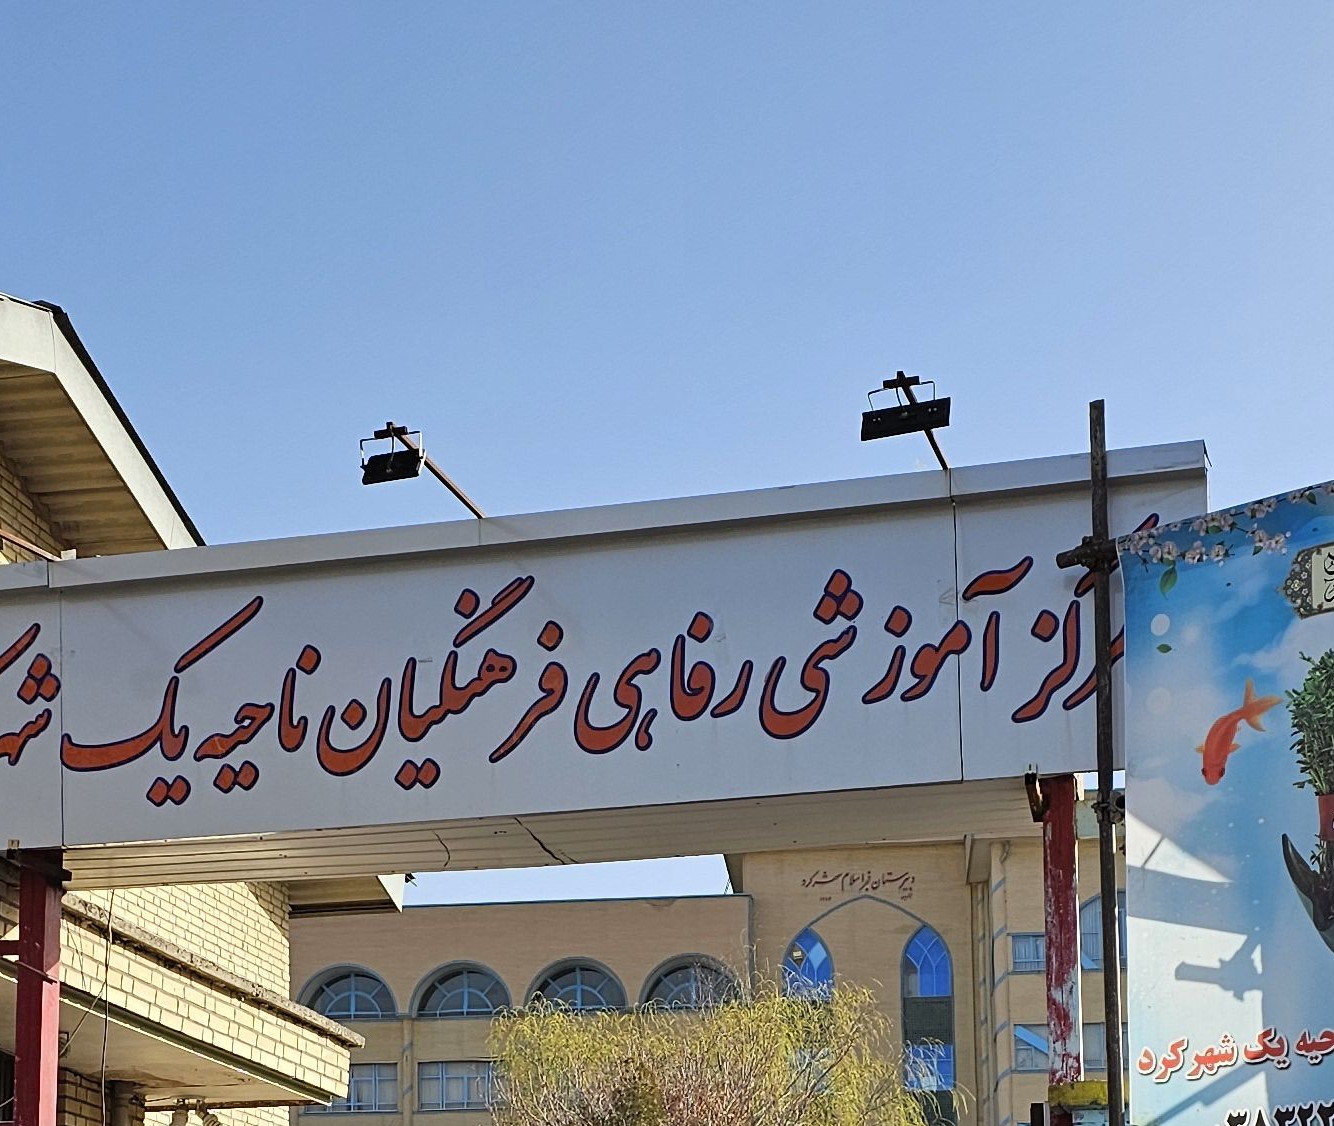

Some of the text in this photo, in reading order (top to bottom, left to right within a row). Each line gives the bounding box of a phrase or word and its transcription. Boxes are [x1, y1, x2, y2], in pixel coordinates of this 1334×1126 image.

[60, 596, 264, 806] یک
[317, 575, 569, 791] فرهنگیان
[573, 610, 753, 755] رفاهی
[759, 555, 1033, 740] آموزشی
[1011, 512, 1159, 723] رکز
[193, 644, 323, 794] ناحیه
[1243, 1027, 1289, 1068] یک
